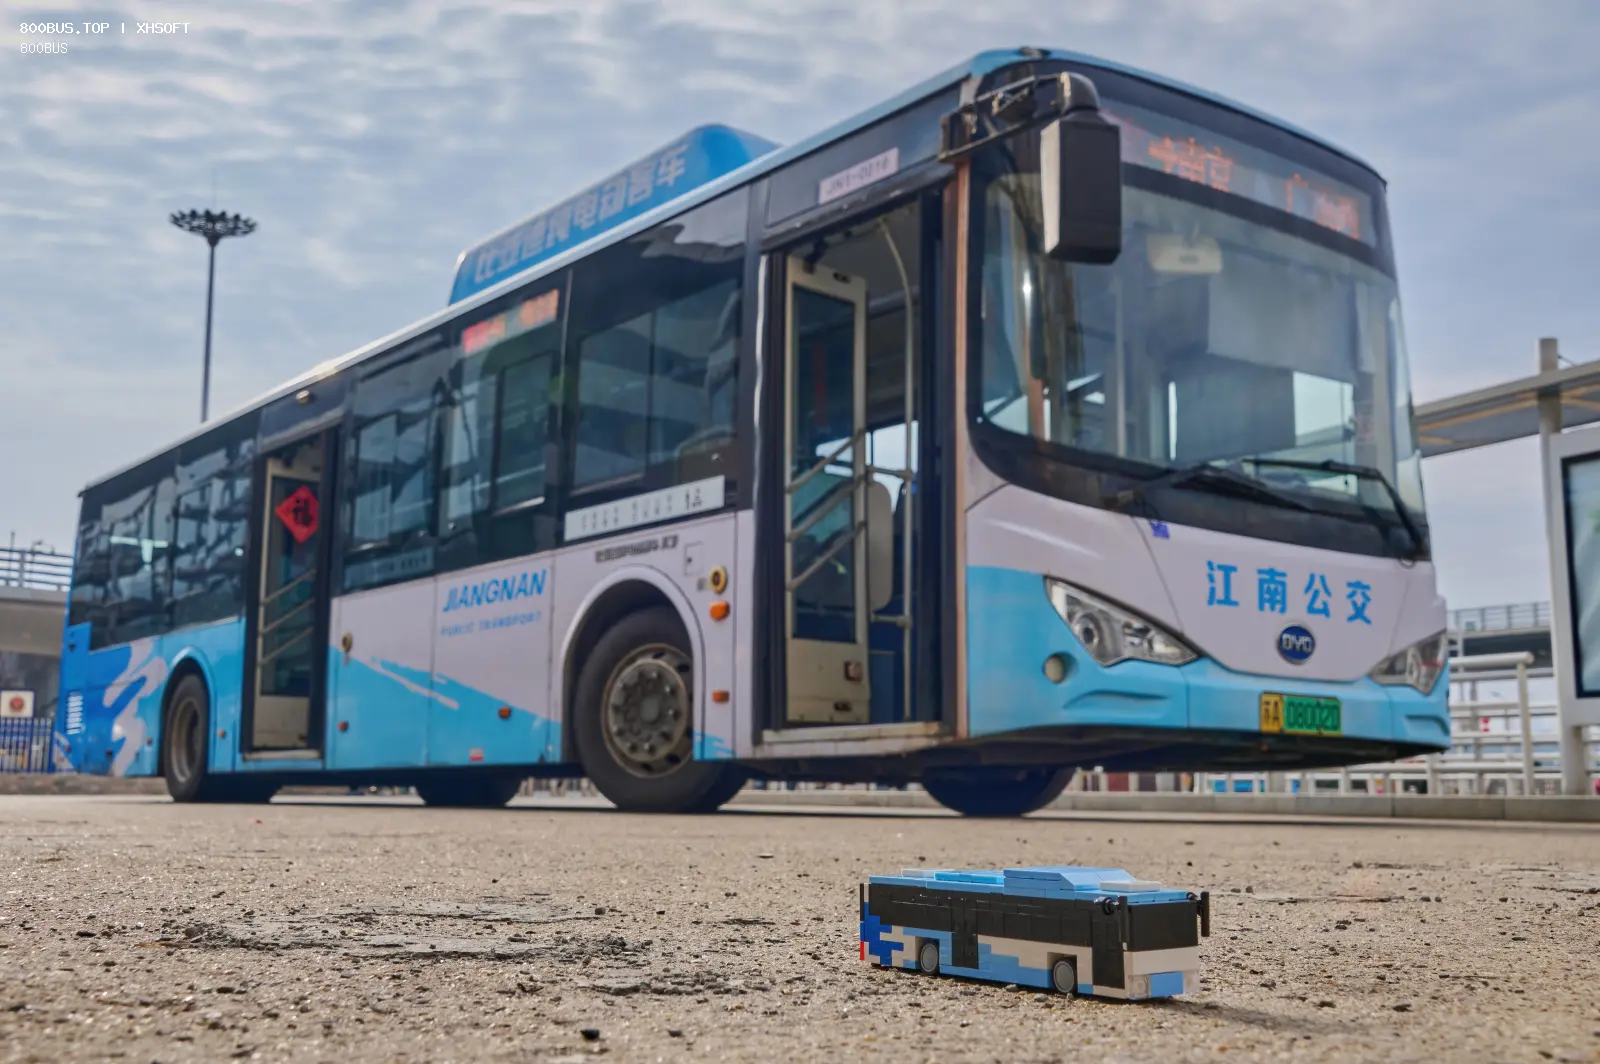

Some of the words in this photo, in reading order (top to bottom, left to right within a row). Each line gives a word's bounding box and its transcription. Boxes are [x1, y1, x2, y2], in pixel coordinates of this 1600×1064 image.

[443, 569, 547, 613] JIANGNAN
[1206, 560, 1372, 625] 江南公交
